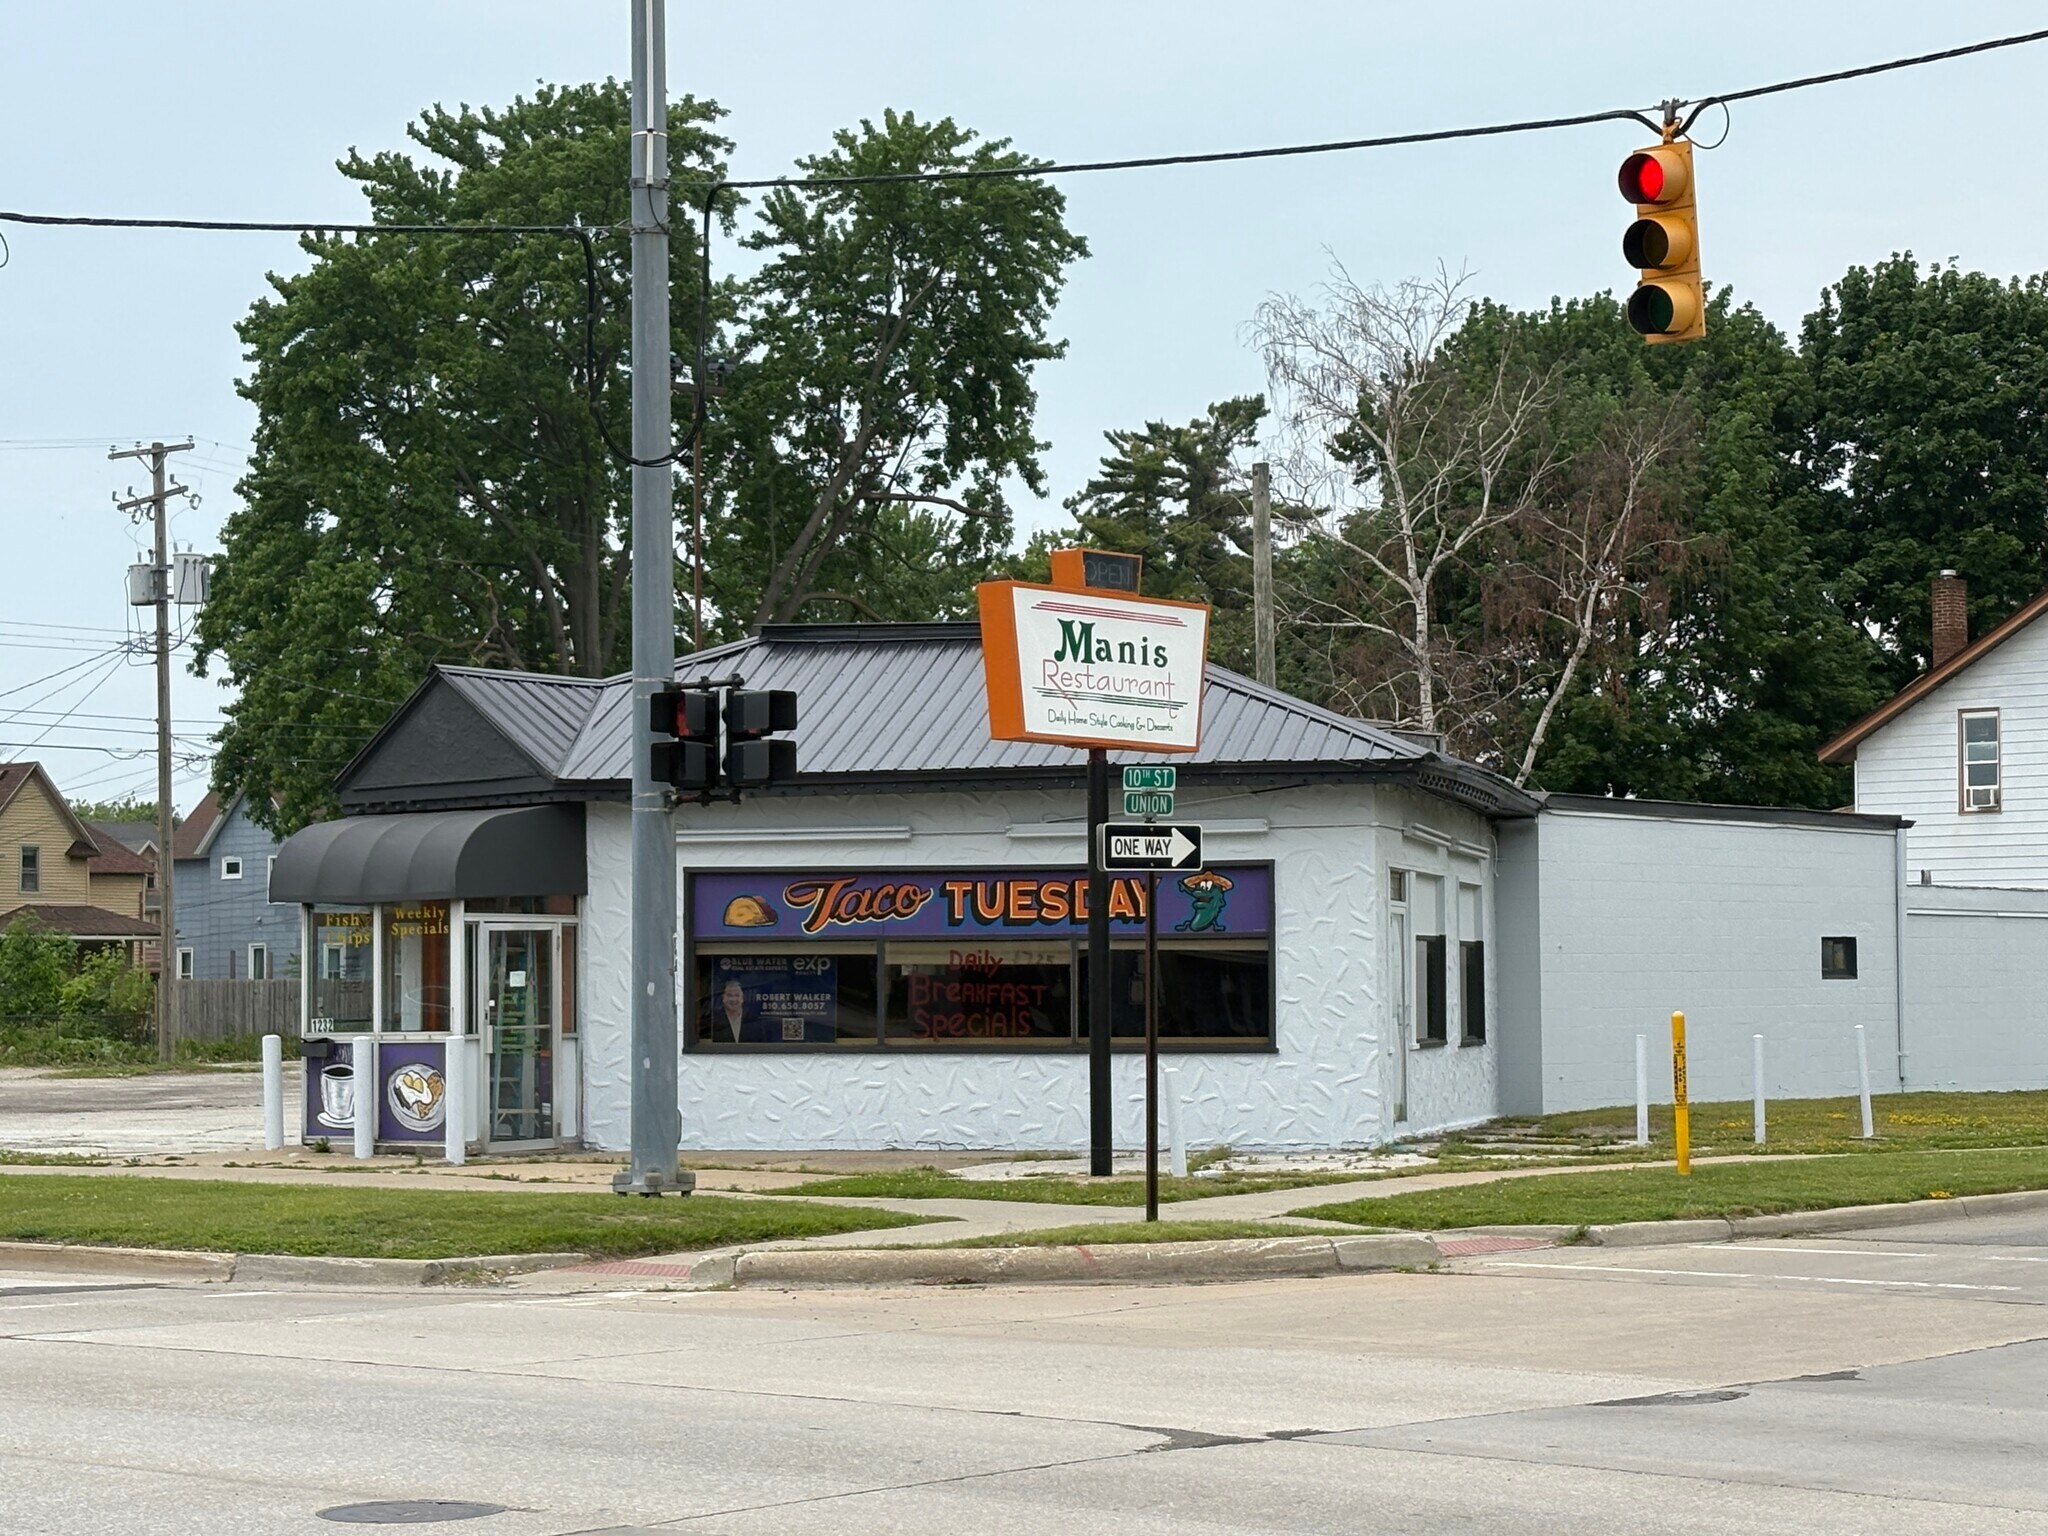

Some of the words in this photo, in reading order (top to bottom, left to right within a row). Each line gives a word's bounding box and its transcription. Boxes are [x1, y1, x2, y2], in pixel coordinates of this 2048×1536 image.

[1085, 559, 1130, 586] OPEN
[1054, 618, 1168, 668] Manis
[1043, 658, 1177, 719] Restaurant
[1048, 708, 1067, 725] Daily
[1068, 710, 1088, 725] Home
[1089, 712, 1108, 728] Style
[1109, 714, 1134, 731] Cooking
[1129, 769, 1150, 786] 10TH
[1154, 769, 1169, 786] ST
[1131, 795, 1167, 812] UNION
[1114, 838, 1140, 856] ONE
[1144, 838, 1172, 856] WAY
[394, 906, 446, 920] Weekly
[783, 876, 933, 935] Taco
[325, 912, 360, 927] Fish
[391, 920, 449, 939] Specials
[756, 993, 791, 1001] ROBERT
[794, 993, 832, 1001] WALKER
[312, 1018, 334, 1033] 1232
